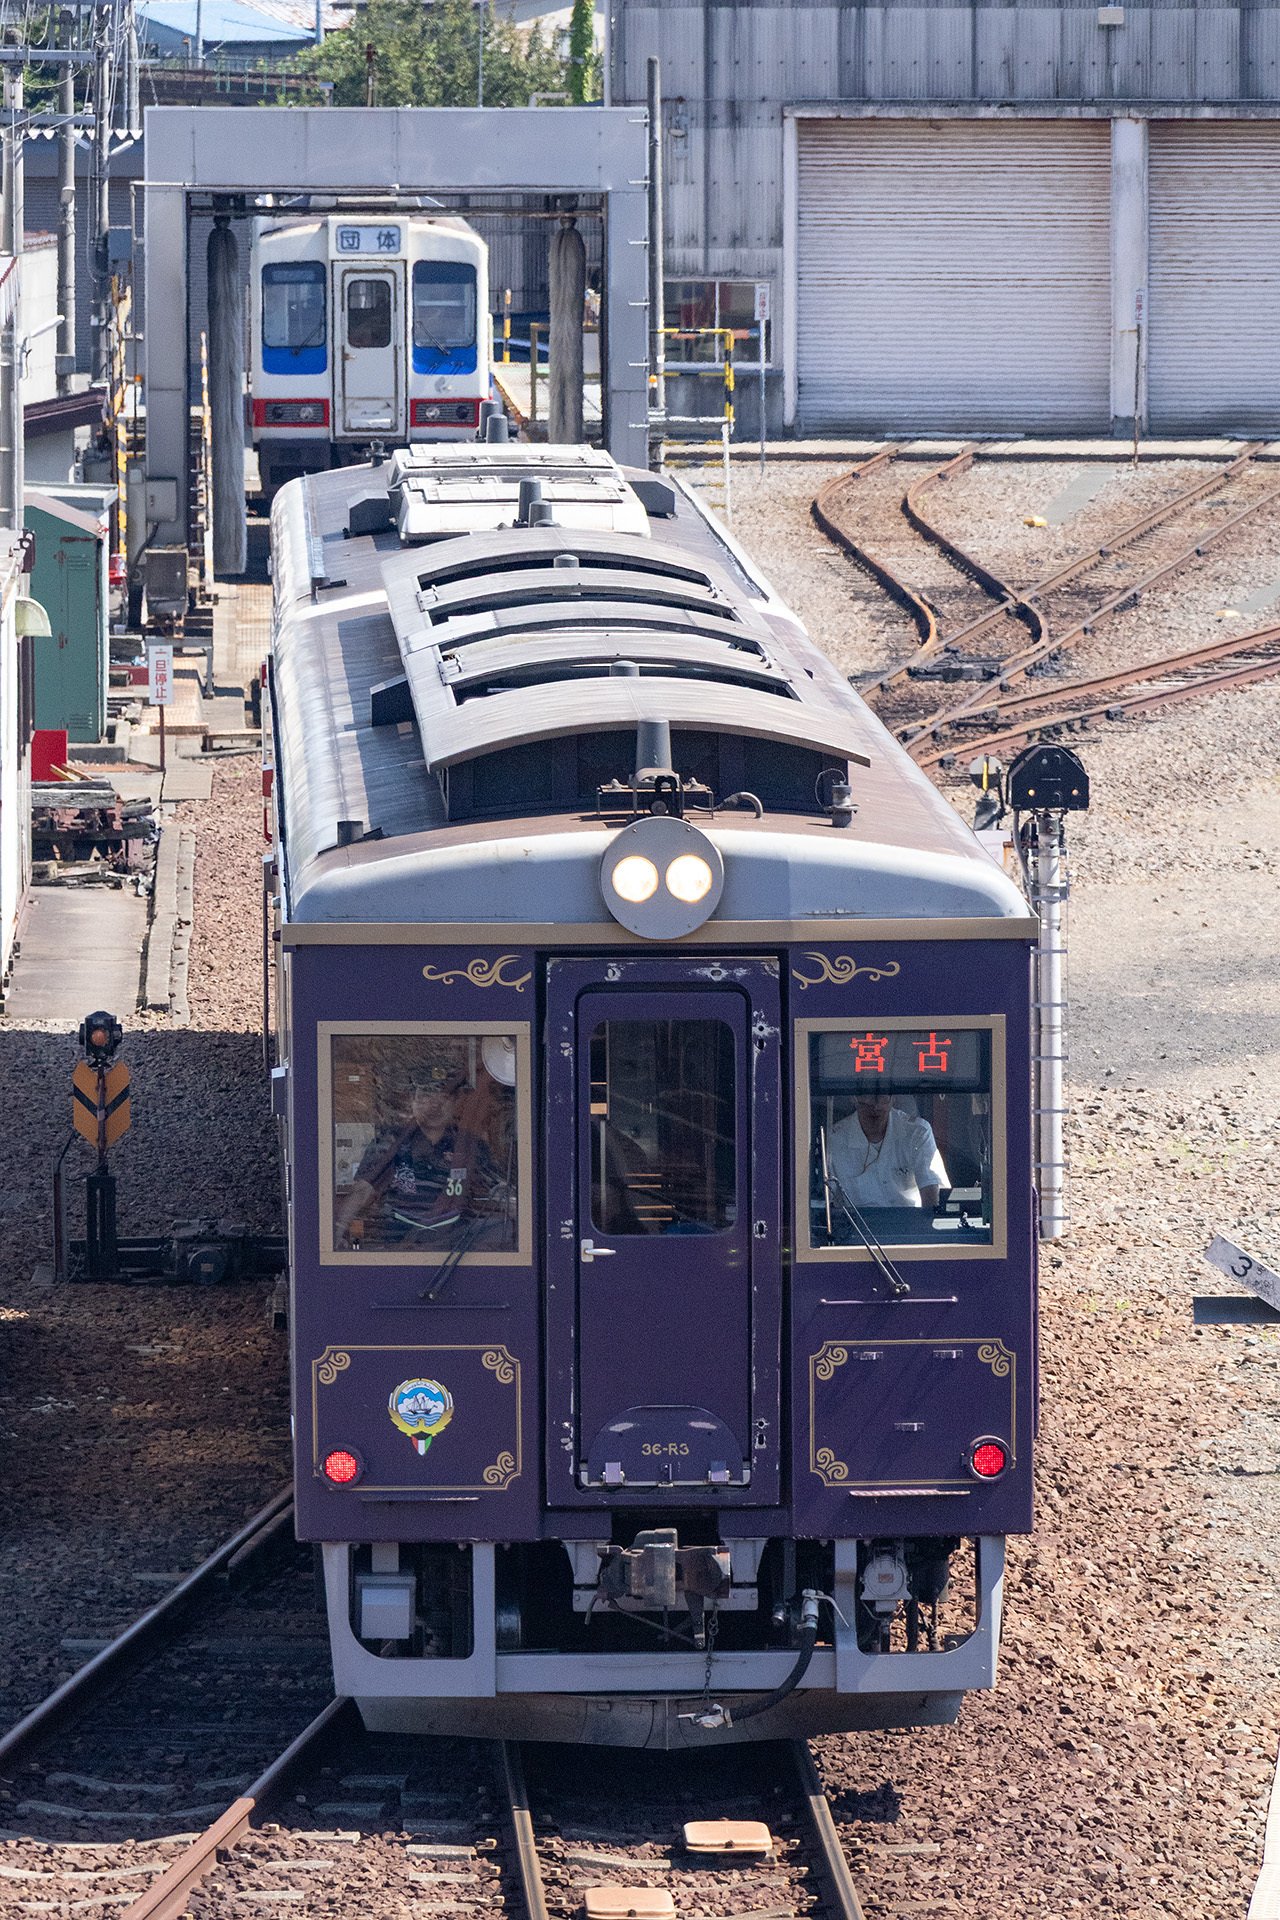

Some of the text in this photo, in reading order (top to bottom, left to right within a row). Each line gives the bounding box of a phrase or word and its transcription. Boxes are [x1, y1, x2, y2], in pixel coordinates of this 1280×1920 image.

[341, 231, 396, 250] 団体
[155, 650, 167, 699] 一旦停止
[849, 1033, 952, 1073] 宮古
[1230, 1256, 1253, 1278] 3
[641, 1443, 690, 1456] 36-R3
